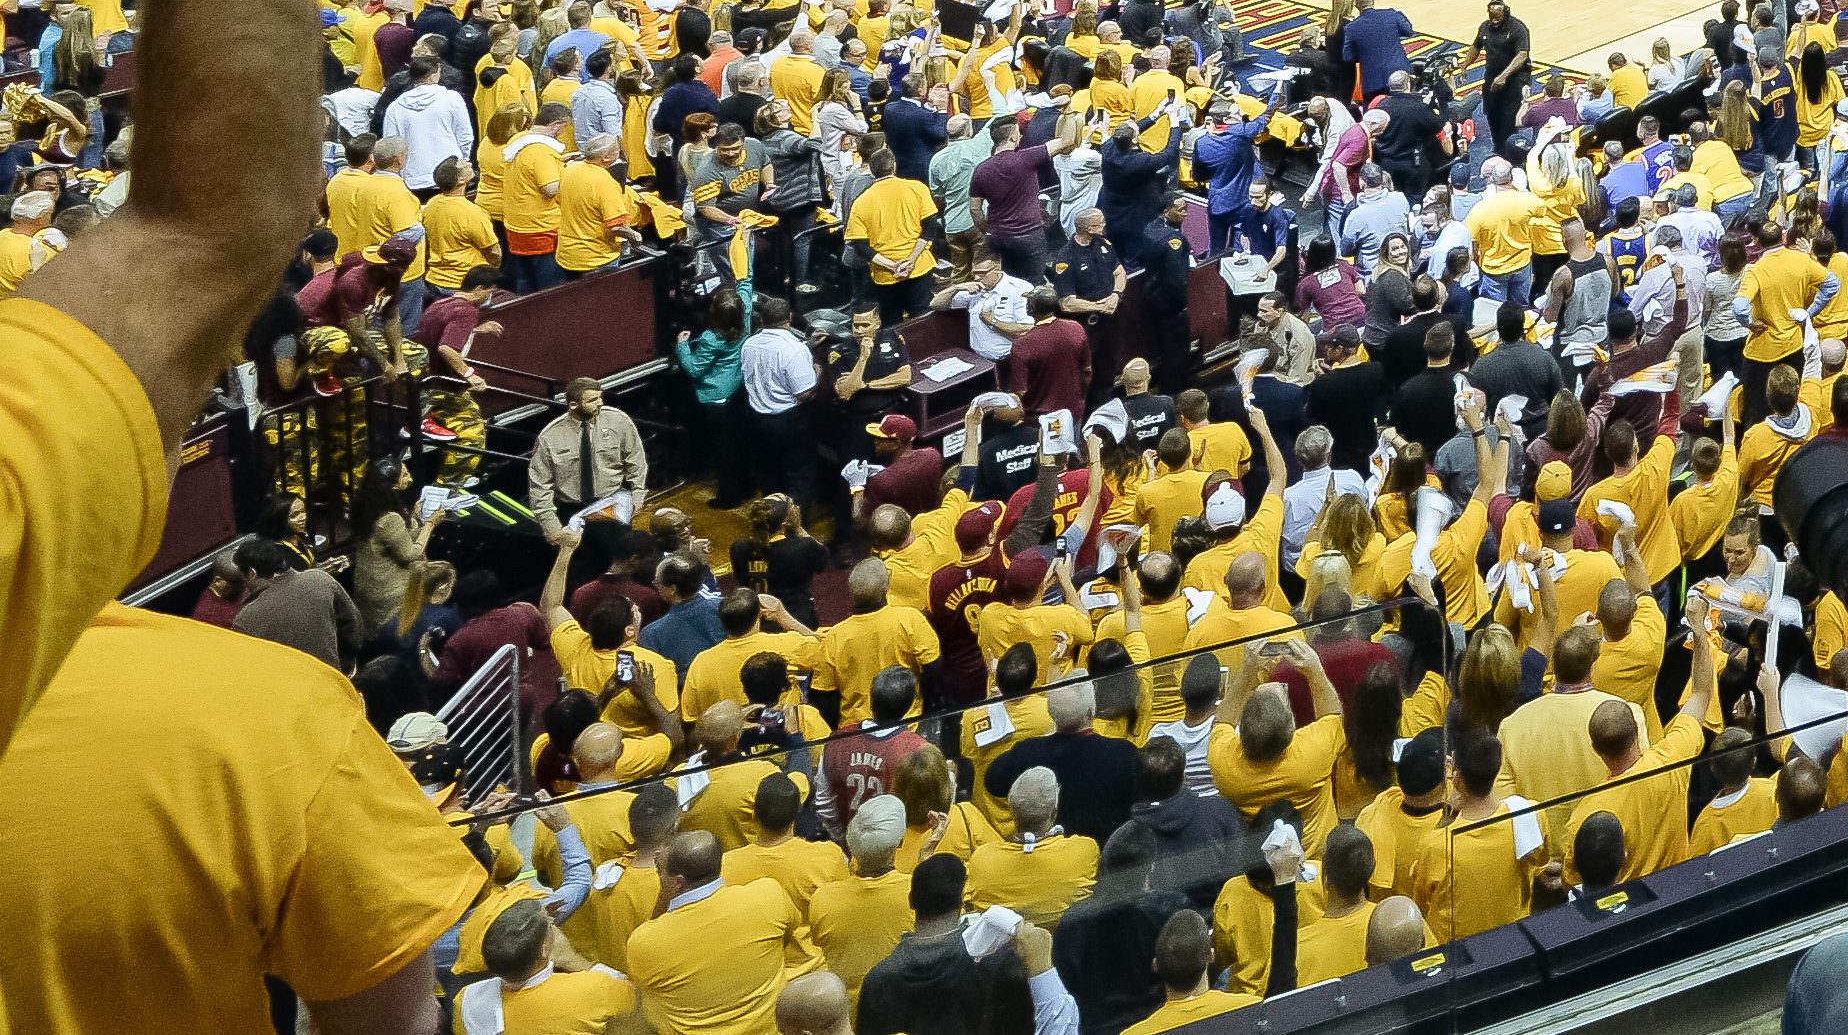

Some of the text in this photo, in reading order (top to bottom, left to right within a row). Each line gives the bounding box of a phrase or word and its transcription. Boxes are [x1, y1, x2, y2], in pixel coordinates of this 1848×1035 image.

[1136, 426, 1159, 441] Staff
[996, 441, 1041, 463] Medical
[1006, 458, 1032, 474] Staff
[1054, 492, 1078, 510] AMES
